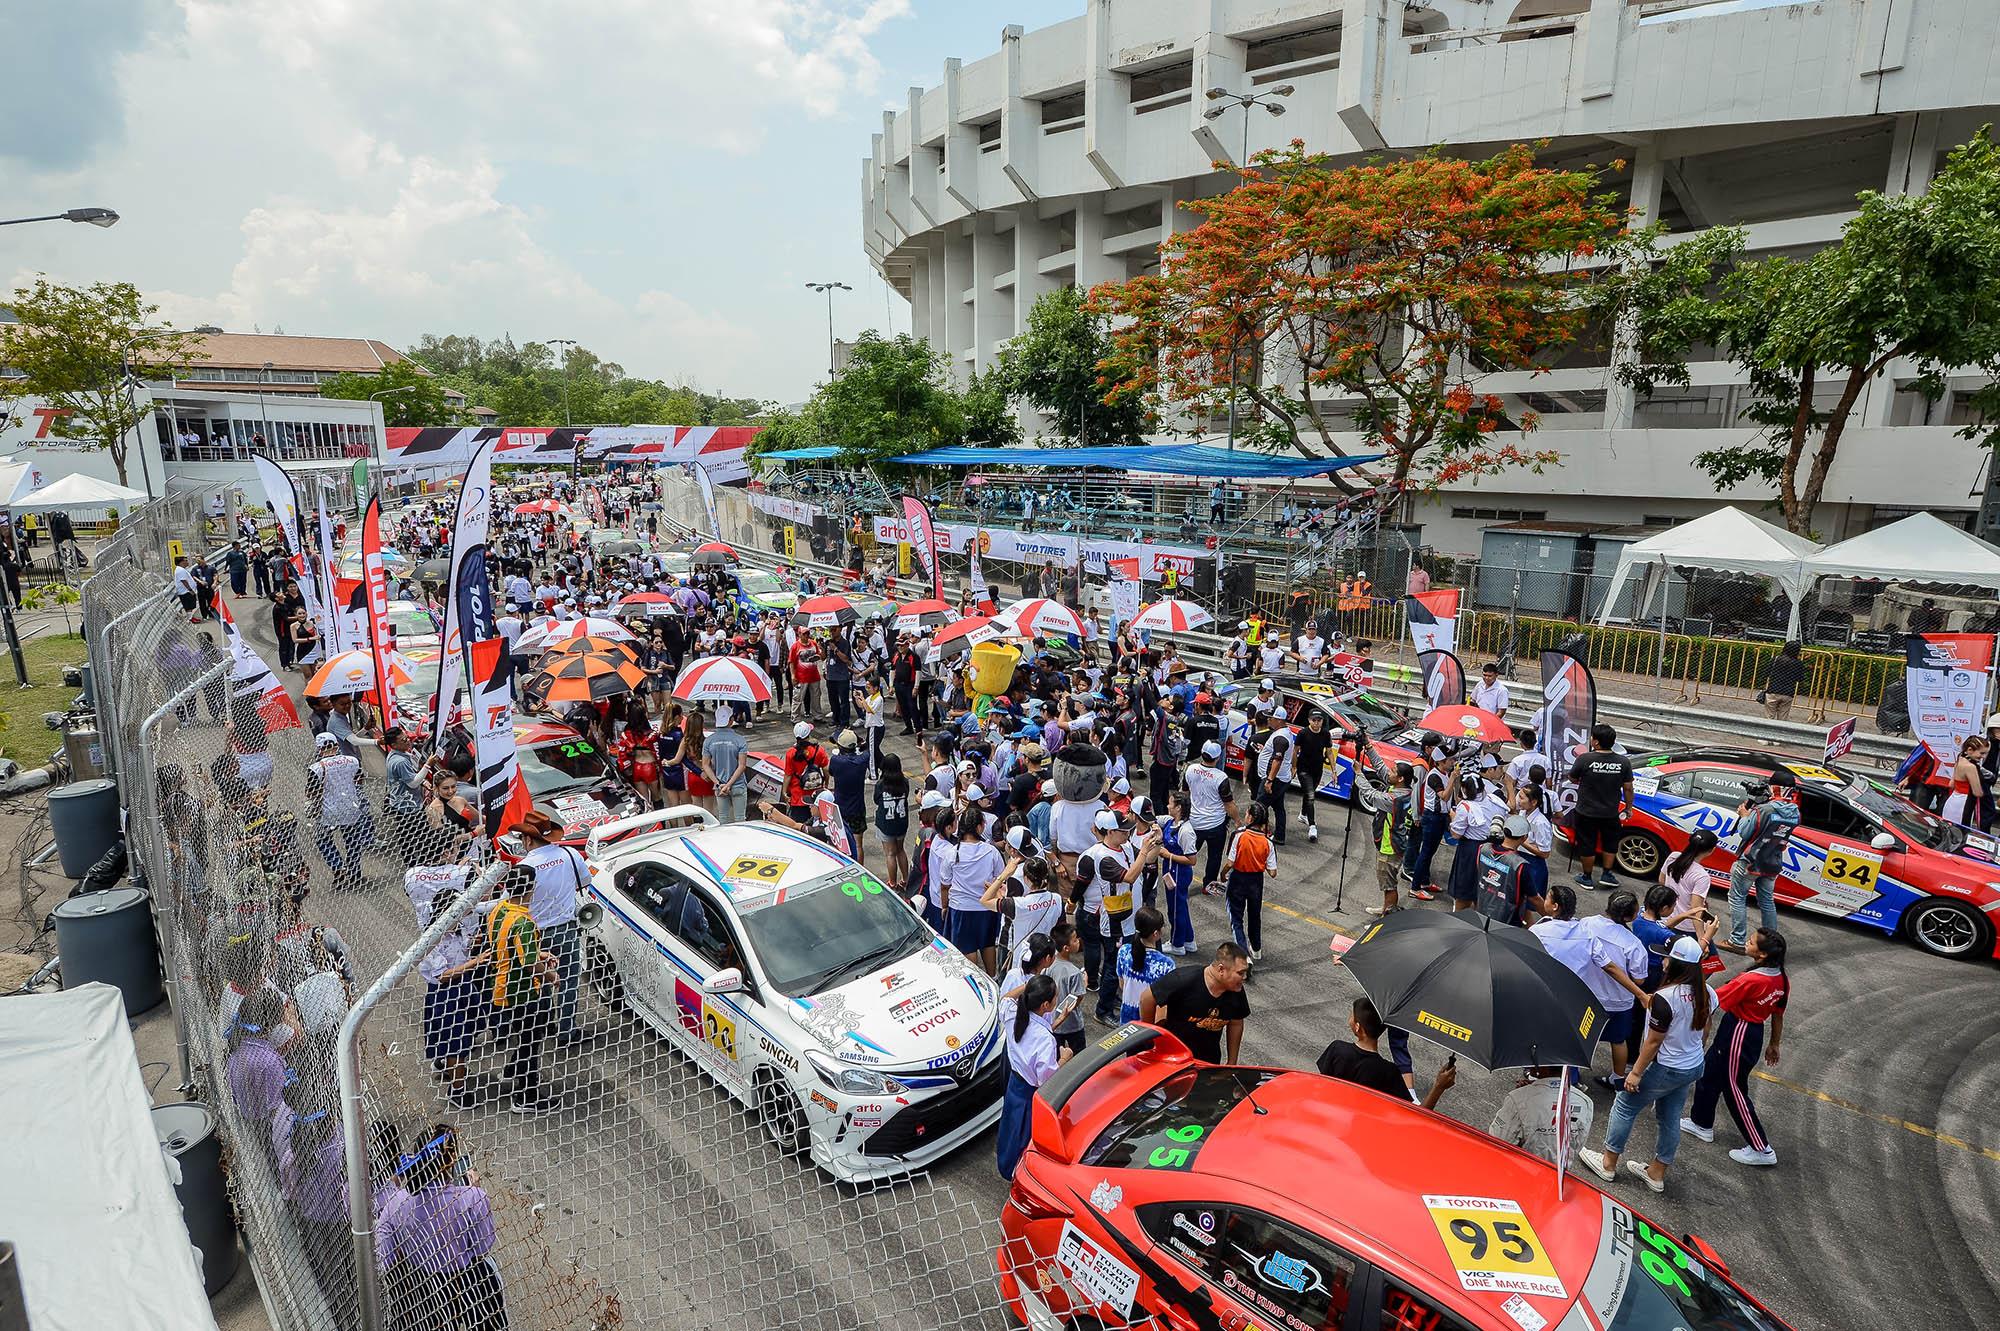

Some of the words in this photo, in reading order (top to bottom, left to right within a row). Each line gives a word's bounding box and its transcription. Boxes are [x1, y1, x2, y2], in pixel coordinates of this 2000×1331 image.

[345, 444, 371, 457] TOYOTA
[880, 525, 907, 540] arto
[1015, 542, 1038, 553] TOYO
[1040, 545, 1066, 557] TIRES
[1342, 664, 1364, 683] 78
[703, 683, 740, 693] FORTRON
[561, 741, 594, 757] 28
[1830, 733, 1850, 758] 34
[1193, 768, 1214, 779] TOYOTA
[1702, 776, 1746, 790] SUGIYAM
[1841, 847, 1870, 859] TOYOTA
[535, 858, 564, 871] TOYOTA
[736, 861, 778, 877] 96
[1827, 857, 1871, 885] 34
[415, 873, 451, 881] TOYOTA
[825, 868, 860, 883] TRD
[1704, 868, 1731, 880] IRES
[842, 875, 882, 903] 96
[1941, 883, 1972, 895] LENSO
[742, 900, 769, 910] TOYOTA
[1027, 899, 1057, 912] TOYOTA
[1860, 908, 1883, 918] arto
[714, 977, 739, 988] MOTUL
[897, 998, 949, 1024] Thailand
[908, 1008, 961, 1037] TOYOTA
[1416, 1010, 1473, 1042] PIRELLI
[1579, 1006, 1595, 1040] PIRELLI
[760, 1037, 799, 1072] SINGHA
[839, 1052, 879, 1064] SAMSUNG
[926, 1052, 960, 1070] TOYO
[960, 1031, 985, 1058] TIRES
[856, 1103, 882, 1112] arto
[854, 1119, 881, 1128] TRD
[1149, 1124, 1204, 1168] 95
[1446, 1199, 1499, 1209] TOYOTA
[1611, 1206, 1634, 1257] TRD
[1449, 1218, 1535, 1263] 95
[1638, 1220, 1691, 1297] 95
[1095, 1260, 1129, 1289] GAZOO
[1099, 1254, 1135, 1285] TOYOTA
[1061, 1250, 1129, 1312] Thailand
[1093, 1265, 1125, 1295] Racing
[1466, 1279, 1492, 1287] ONE
[1495, 1280, 1529, 1290] MAKE
[1531, 1282, 1563, 1294] RACE
[1236, 1282, 1256, 1301] THE
[1257, 1294, 1285, 1319] KUMP
